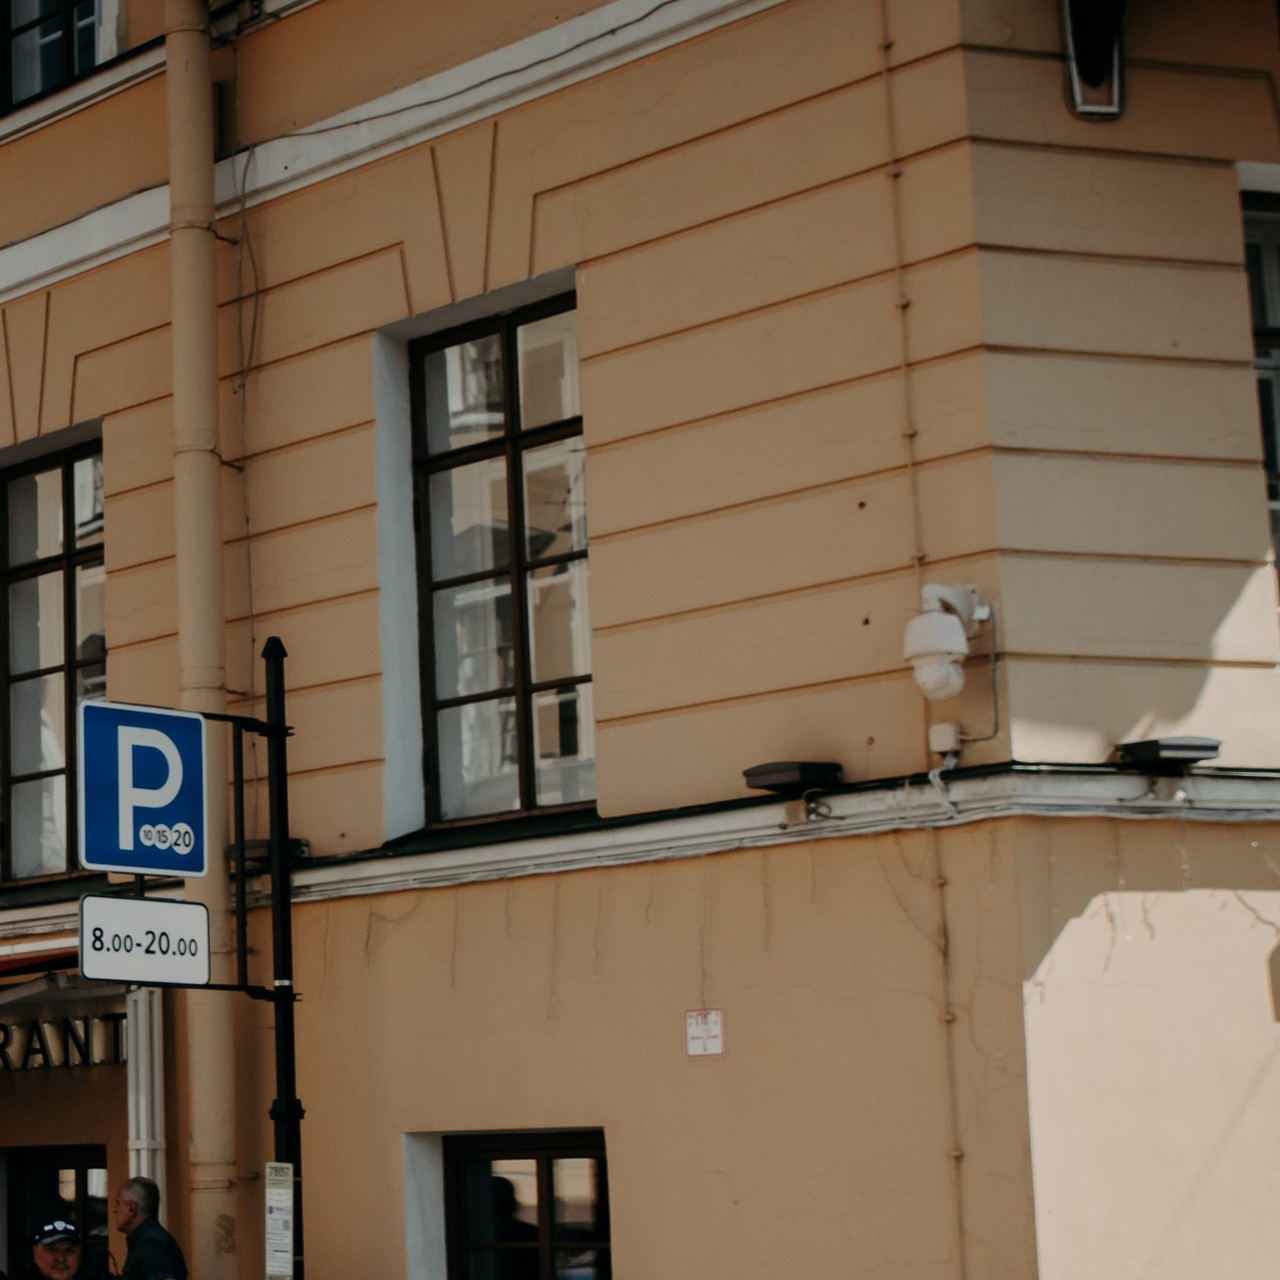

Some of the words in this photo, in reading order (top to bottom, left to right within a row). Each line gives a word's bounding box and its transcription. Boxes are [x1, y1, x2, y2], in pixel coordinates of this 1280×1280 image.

[117, 725, 184, 850] P
[143, 830, 153, 841] 10
[157, 830, 168, 844] 15
[173, 829, 192, 848] 20
[91, 927, 198, 957] 8.00-20.00
